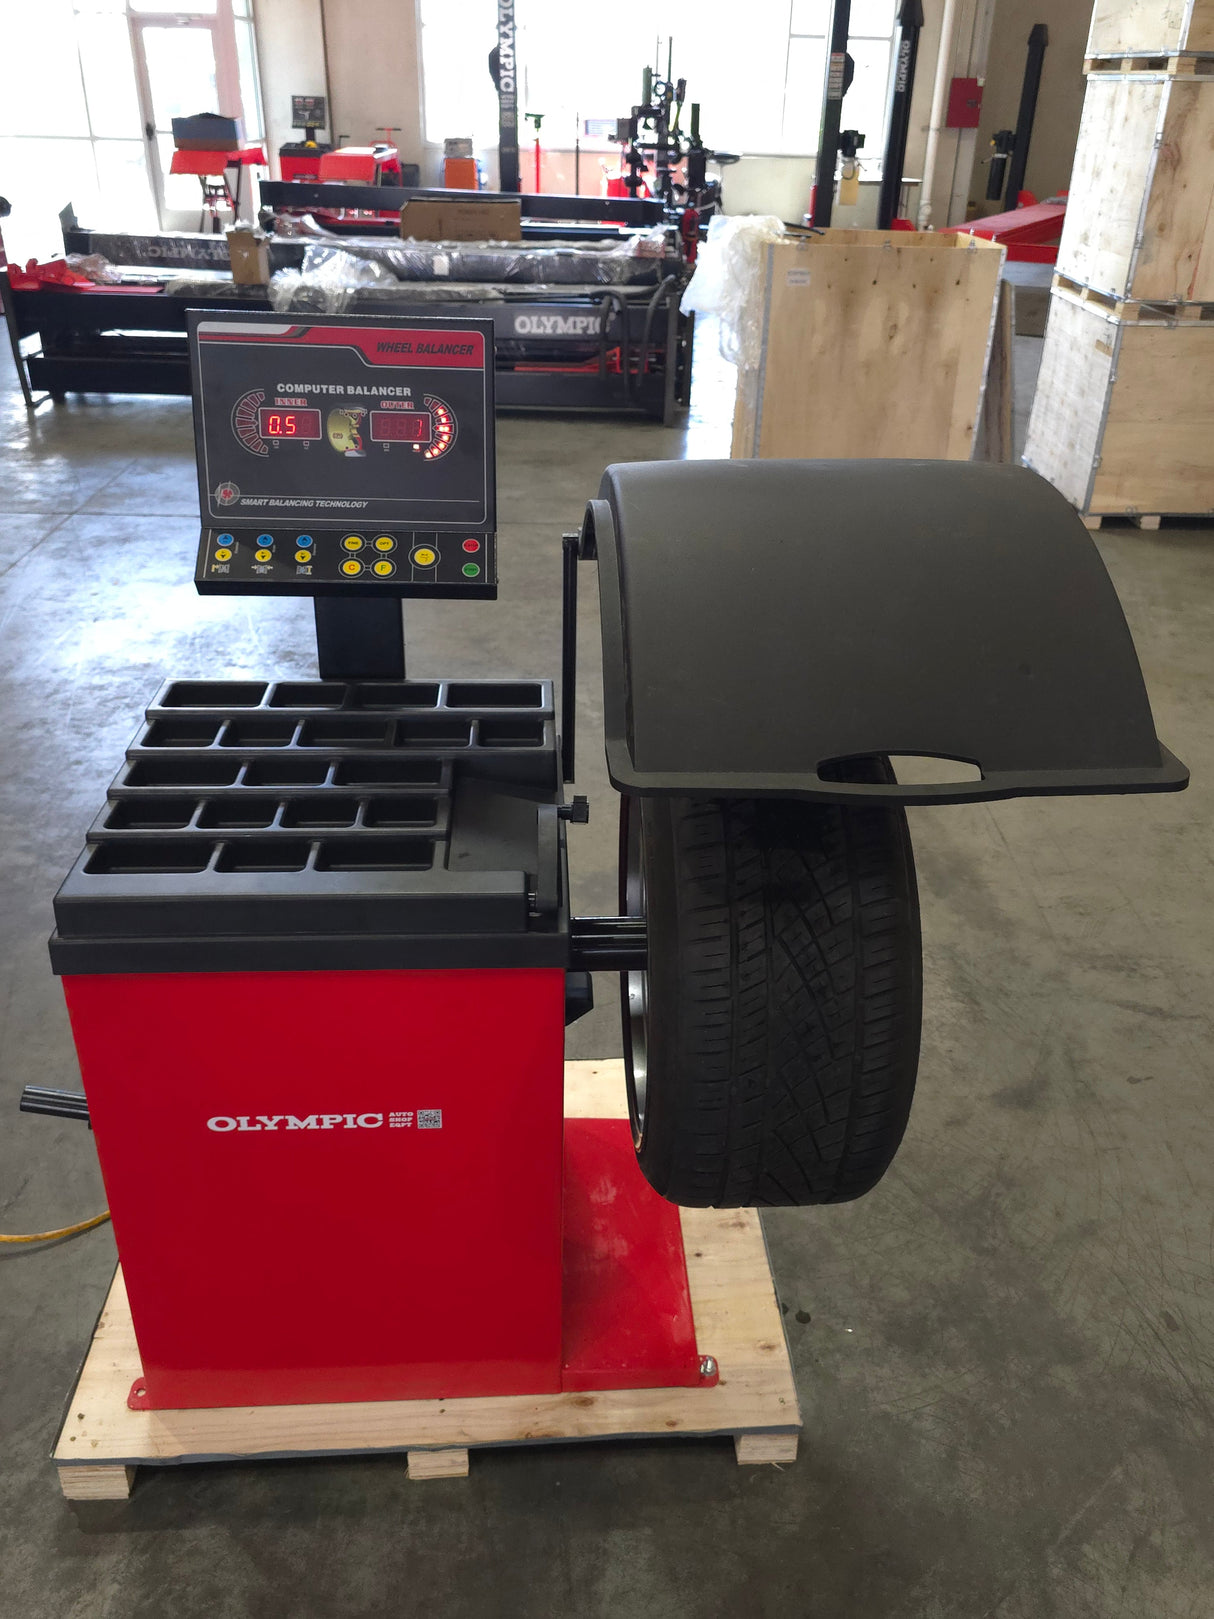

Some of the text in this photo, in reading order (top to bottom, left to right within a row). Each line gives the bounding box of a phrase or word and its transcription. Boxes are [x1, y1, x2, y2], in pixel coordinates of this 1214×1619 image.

[376, 342, 474, 355] WHEEL BALANCER
[276, 383, 412, 396] COMPUTER BALANCER
[274, 397, 308, 407] INNER
[381, 401, 415, 410] OUTER
[268, 414, 297, 435] 0.5
[240, 498, 369, 509] SMART BALANCING TECHNOLOGY
[380, 564, 387, 572] F
[206, 1112, 384, 1132] OLYMPIC
